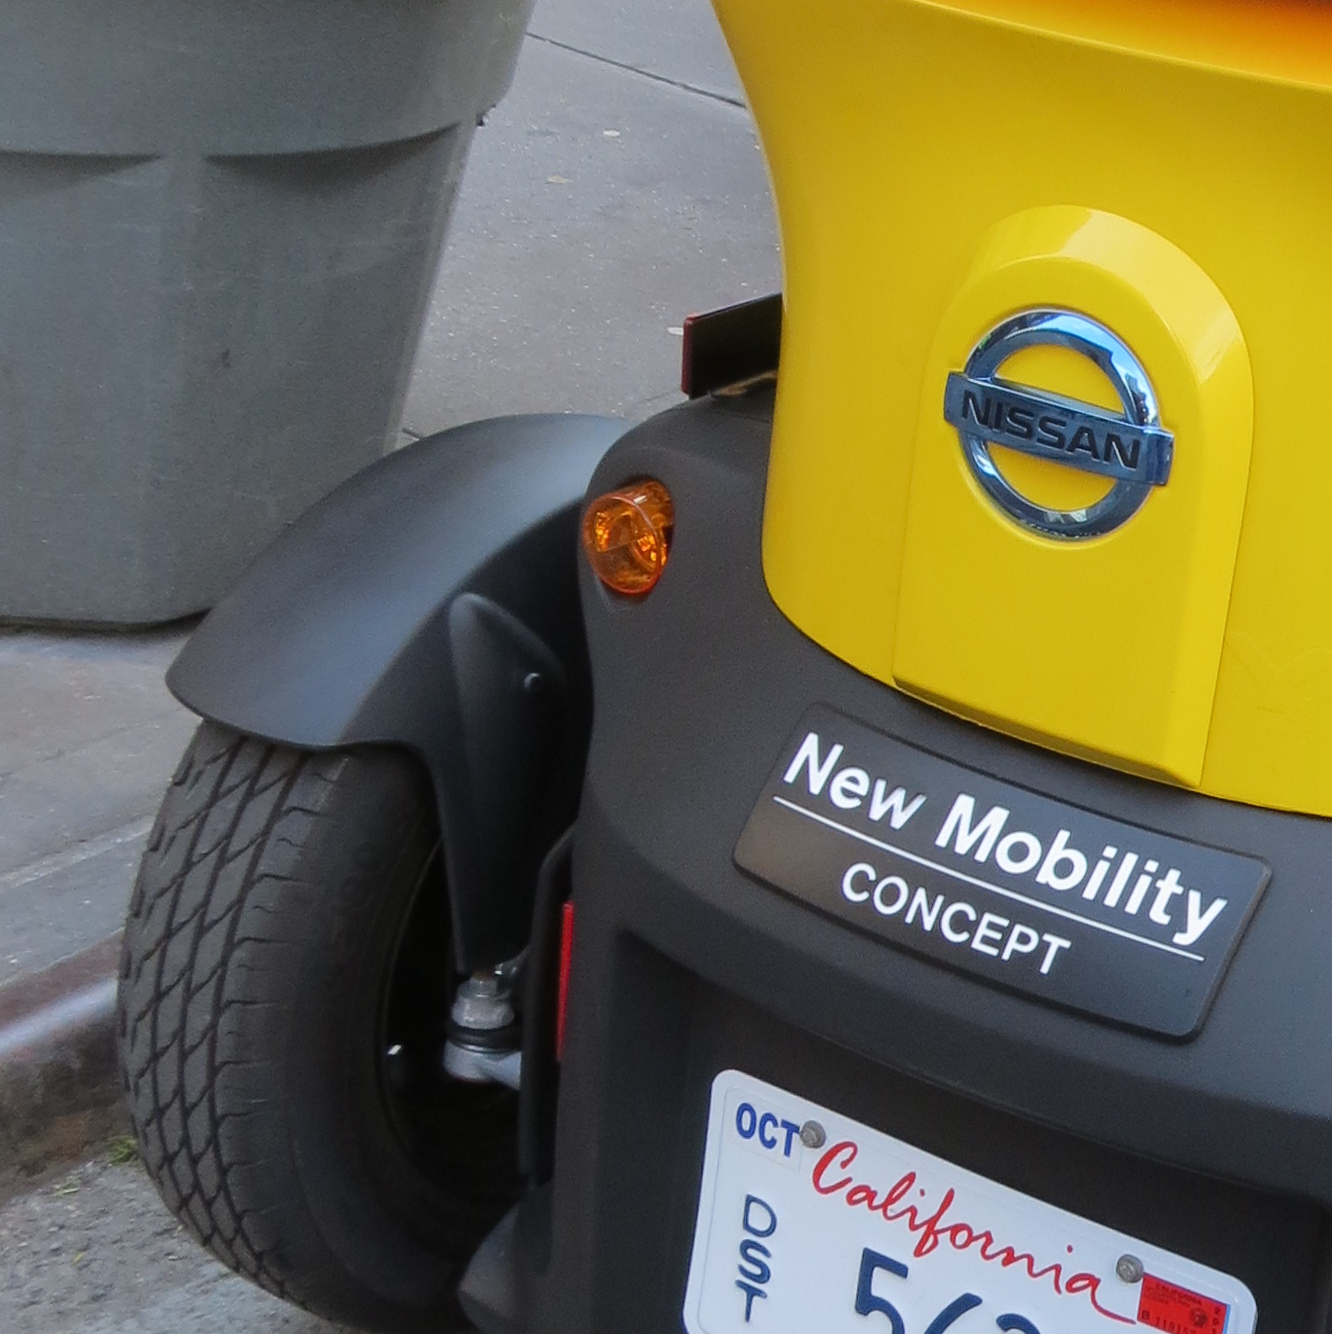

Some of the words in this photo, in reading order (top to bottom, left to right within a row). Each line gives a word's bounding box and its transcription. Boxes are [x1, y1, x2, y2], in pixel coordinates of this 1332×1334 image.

[960, 389, 1141, 471] NISSAN
[783, 731, 927, 830] New
[935, 793, 1228, 947] Mobility
[841, 863, 1071, 975] CONCEPT
[736, 1102, 800, 1158] OCT
[812, 1140, 1138, 1326] California
